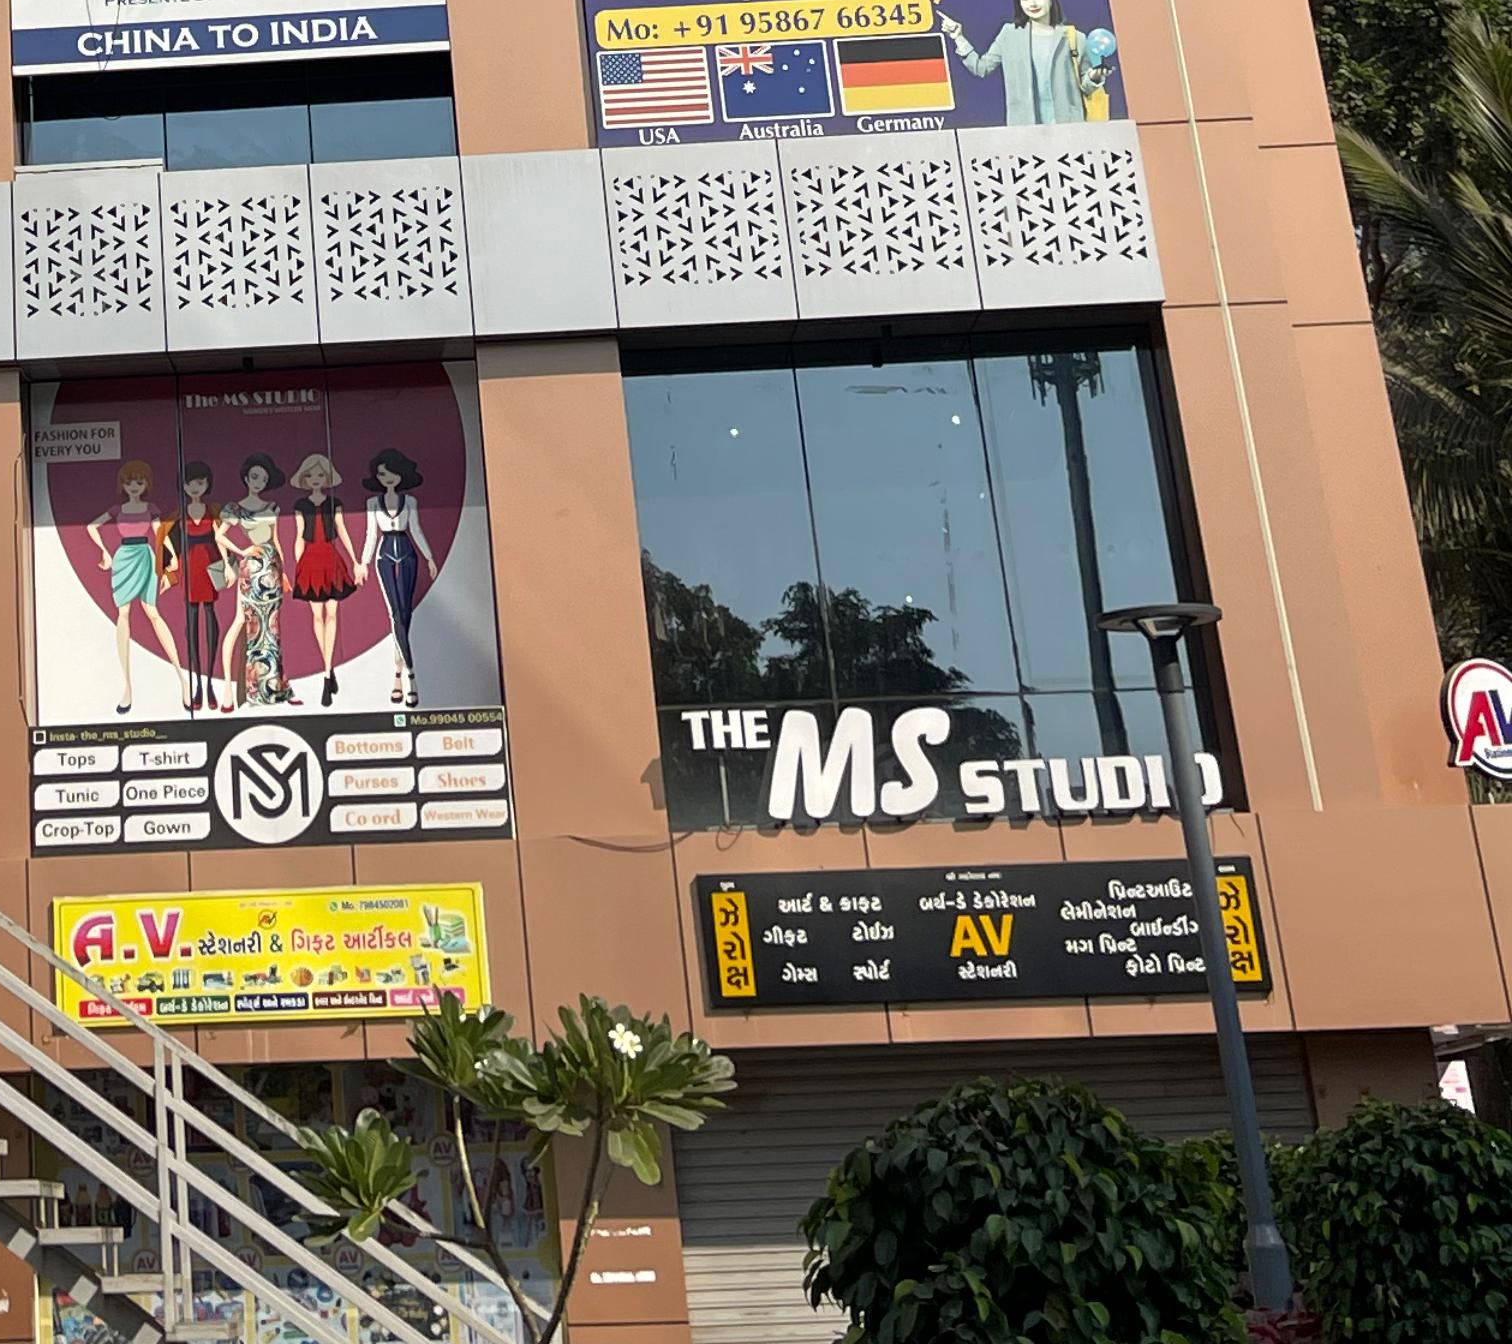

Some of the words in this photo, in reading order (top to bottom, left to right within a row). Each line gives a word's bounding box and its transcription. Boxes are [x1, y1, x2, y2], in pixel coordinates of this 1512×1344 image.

[607, 19, 659, 42] Mo:
[673, 12, 729, 36] +91
[741, 8, 825, 34] 95867
[838, 3, 922, 29] 66345
[77, 26, 197, 58] CHINA
[208, 22, 259, 50] TO
[270, 15, 379, 45] INDIA
[739, 120, 824, 141] Australia
[856, 113, 945, 136] Germany
[639, 128, 680, 146] USA
[222, 392, 248, 406] MS
[252, 388, 321, 405] STUDIO
[34, 428, 87, 442] FASHION
[90, 426, 115, 440] FOR
[34, 444, 73, 459] EVERY
[75, 443, 102, 456] YOU
[334, 740, 403, 755] Bottoms
[442, 736, 475, 751] Belt
[57, 752, 96, 768] Tops
[139, 750, 190, 766] T-shirt
[681, 709, 771, 751] THE
[768, 707, 951, 821] MS
[344, 774, 399, 789] Purses
[437, 772, 486, 788] Shoes
[56, 788, 99, 804] Tunic
[126, 785, 158, 801] One
[164, 784, 206, 799] Piece
[345, 811, 367, 826] Co
[372, 809, 402, 825] ord
[42, 820, 115, 840] Crop-Top
[144, 818, 192, 835] Gown
[777, 891, 814, 914] આર્ટ
[819, 896, 834, 913] &
[73, 908, 193, 968] A.V.
[198, 930, 262, 957] સ્ટેશનરી
[269, 934, 283, 953] &
[949, 914, 1014, 958] AV
